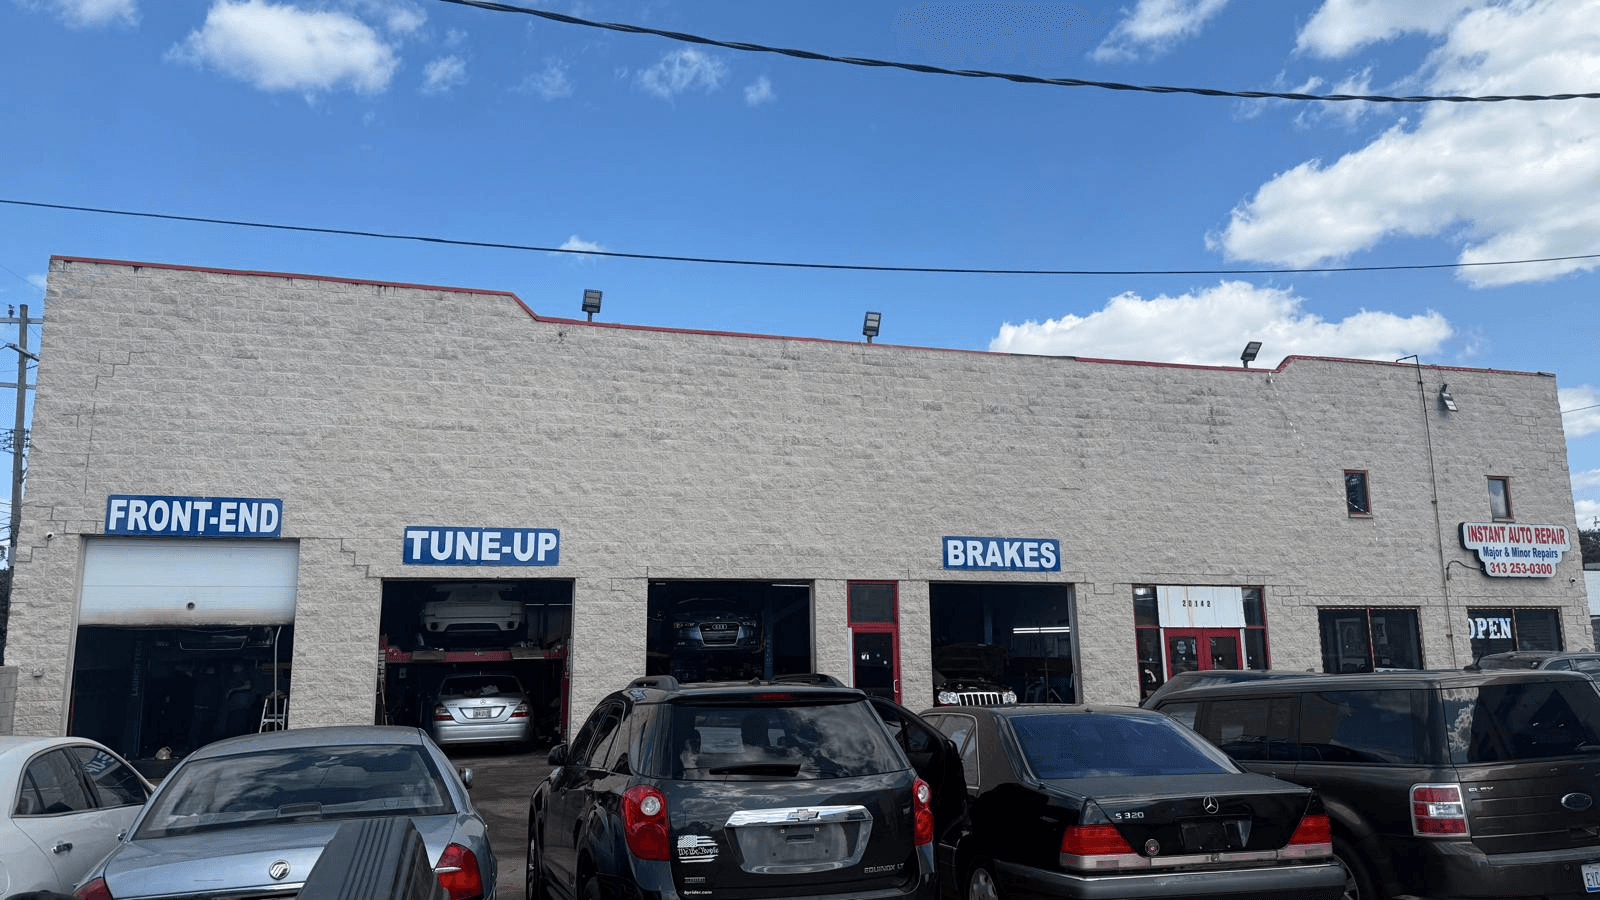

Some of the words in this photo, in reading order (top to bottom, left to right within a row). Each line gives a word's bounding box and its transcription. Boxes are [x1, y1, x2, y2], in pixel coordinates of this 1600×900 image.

[109, 499, 279, 533] FRONT-END
[1467, 525, 1506, 543] INSTANT
[1508, 527, 1532, 544] AUTO
[1534, 527, 1566, 545] REPAIR
[406, 530, 558, 562] TUNE-UP
[947, 539, 1057, 569] BRAKES
[1482, 546, 1502, 560] Major
[1504, 547, 1510, 557] &
[1511, 547, 1531, 558] Minor
[1532, 548, 1558, 561] Repairs
[1490, 562, 1507, 574] 313
[1509, 562, 1553, 575] 253-0300
[1115, 812, 1122, 820] S
[1123, 811, 1145, 819] 320
[864, 865, 896, 874] EQUINOX
